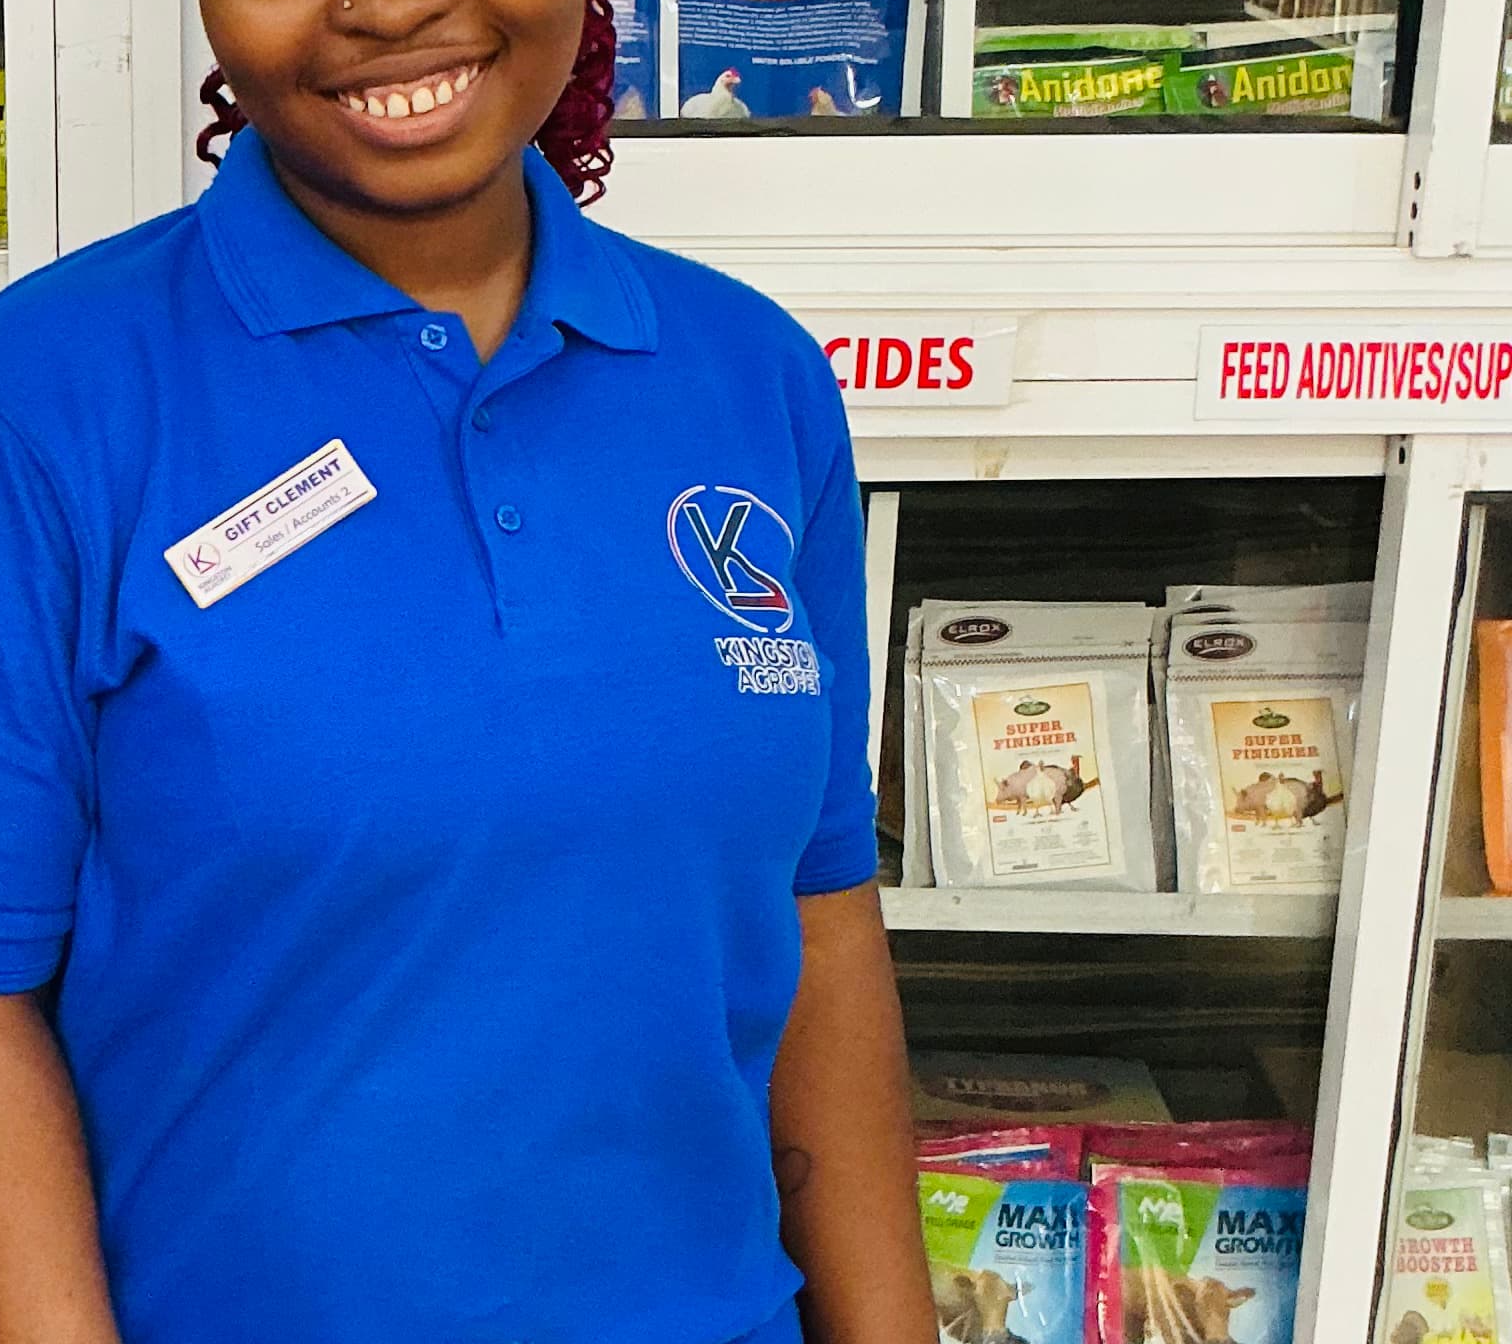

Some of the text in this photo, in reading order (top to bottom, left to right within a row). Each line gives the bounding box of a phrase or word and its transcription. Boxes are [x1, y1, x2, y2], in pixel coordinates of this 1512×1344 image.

[1019, 62, 1164, 103] Anidone
[1220, 342, 1290, 400] FEED
[225, 458, 342, 542] GIFT CLEMENT
[255, 529, 285, 553] Sales
[292, 493, 340, 530] Accounts
[343, 486, 352, 497] 2
[948, 622, 1002, 635] ELROX
[1193, 637, 1245, 649] ELROX
[1006, 719, 1064, 736] SUPER
[993, 731, 1077, 751] FINISHER
[1244, 734, 1303, 747] SUPER
[1232, 745, 1320, 761] FINISHER
[1394, 1255, 1479, 1274] BOOSTER
